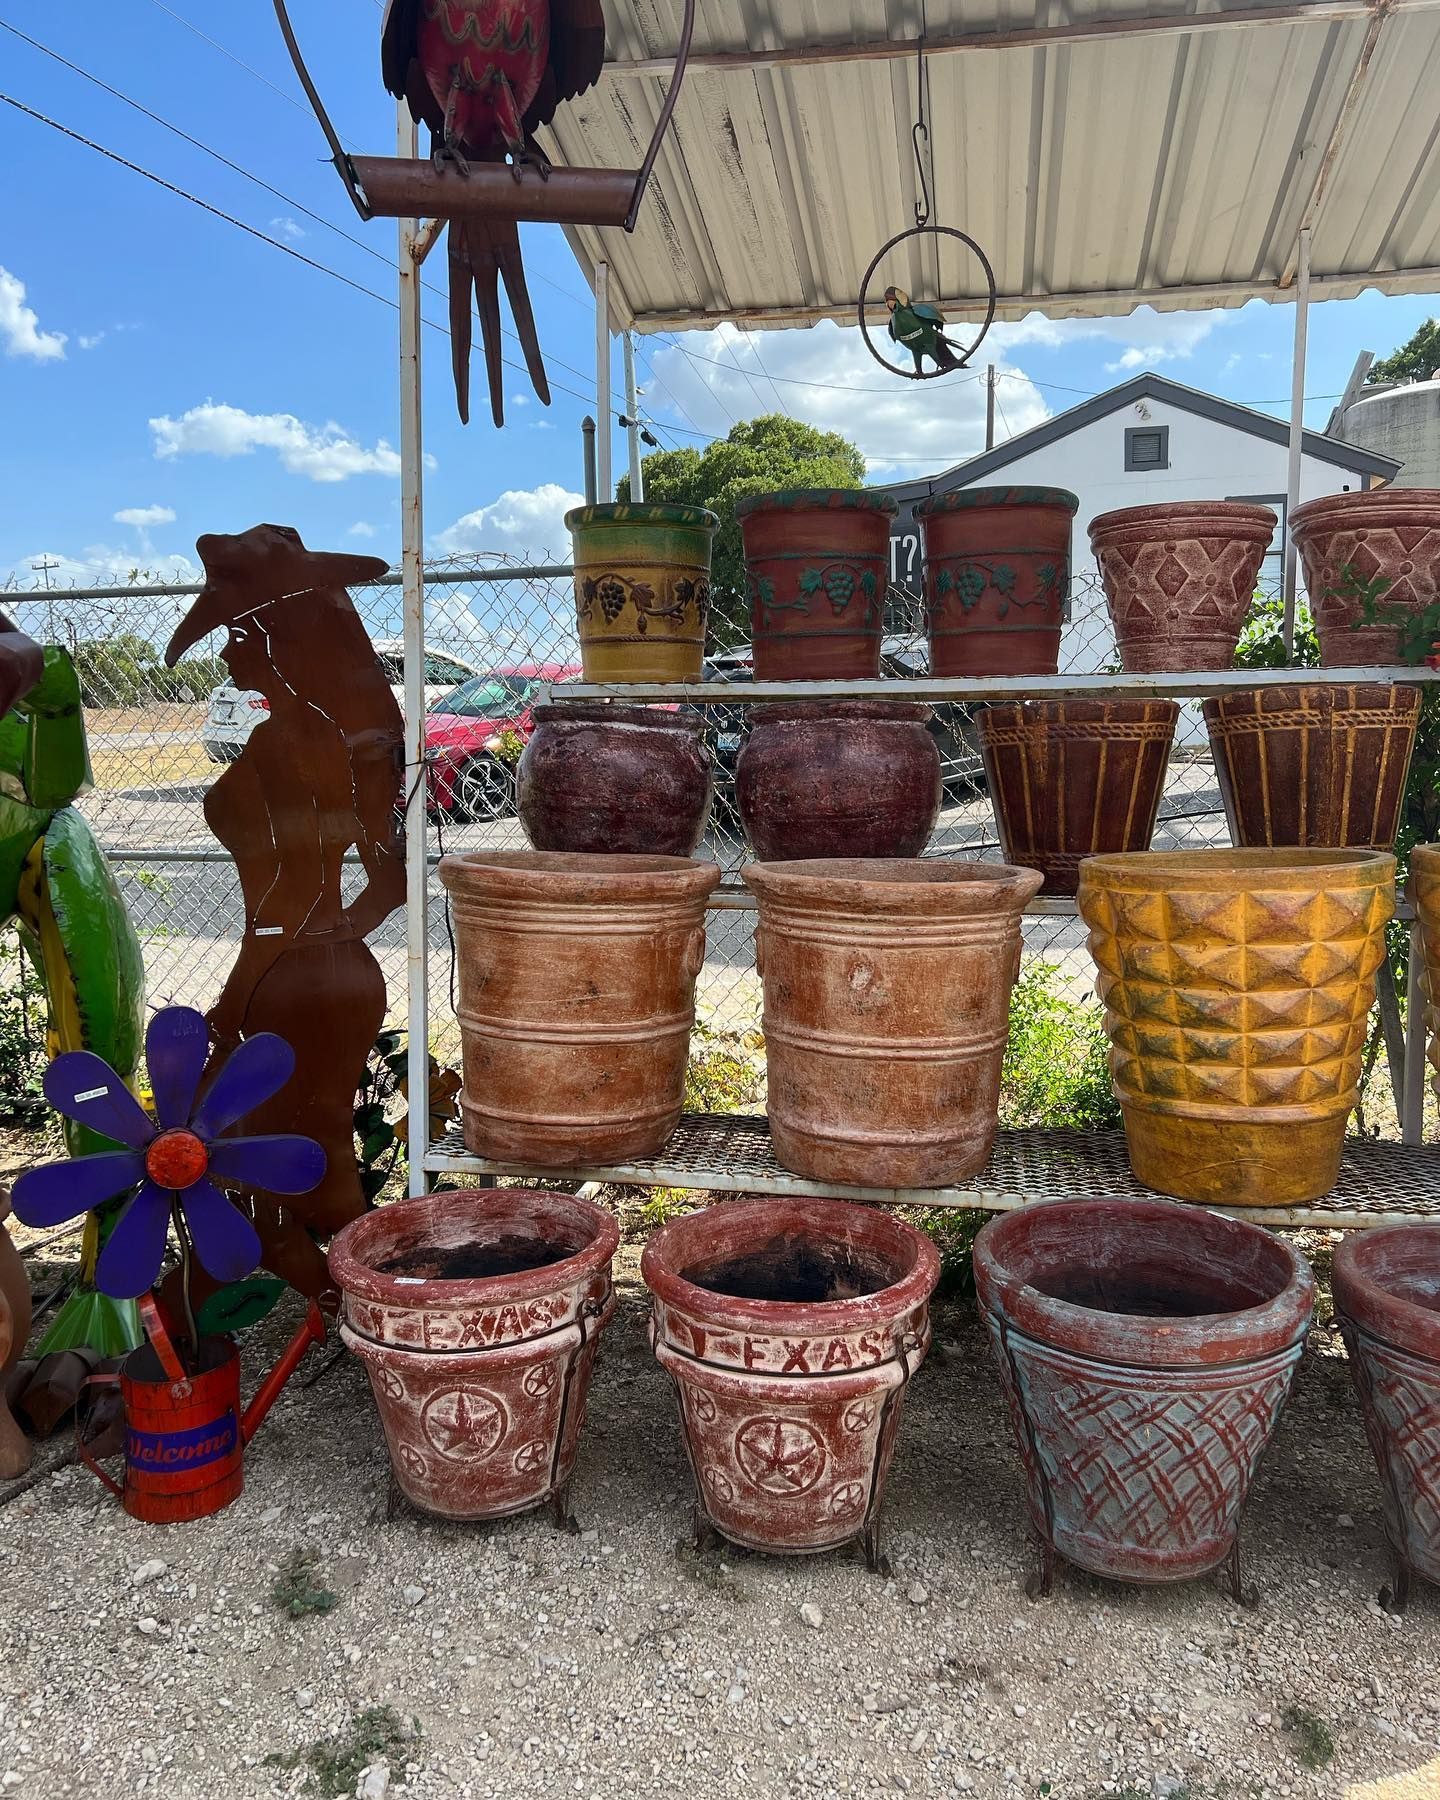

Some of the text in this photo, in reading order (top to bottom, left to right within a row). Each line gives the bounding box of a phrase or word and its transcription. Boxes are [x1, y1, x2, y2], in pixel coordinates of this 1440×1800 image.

[359, 1298, 553, 1349] TEXAS
[678, 1314, 882, 1374] TEXAS
[129, 1428, 232, 1463] Welcome
